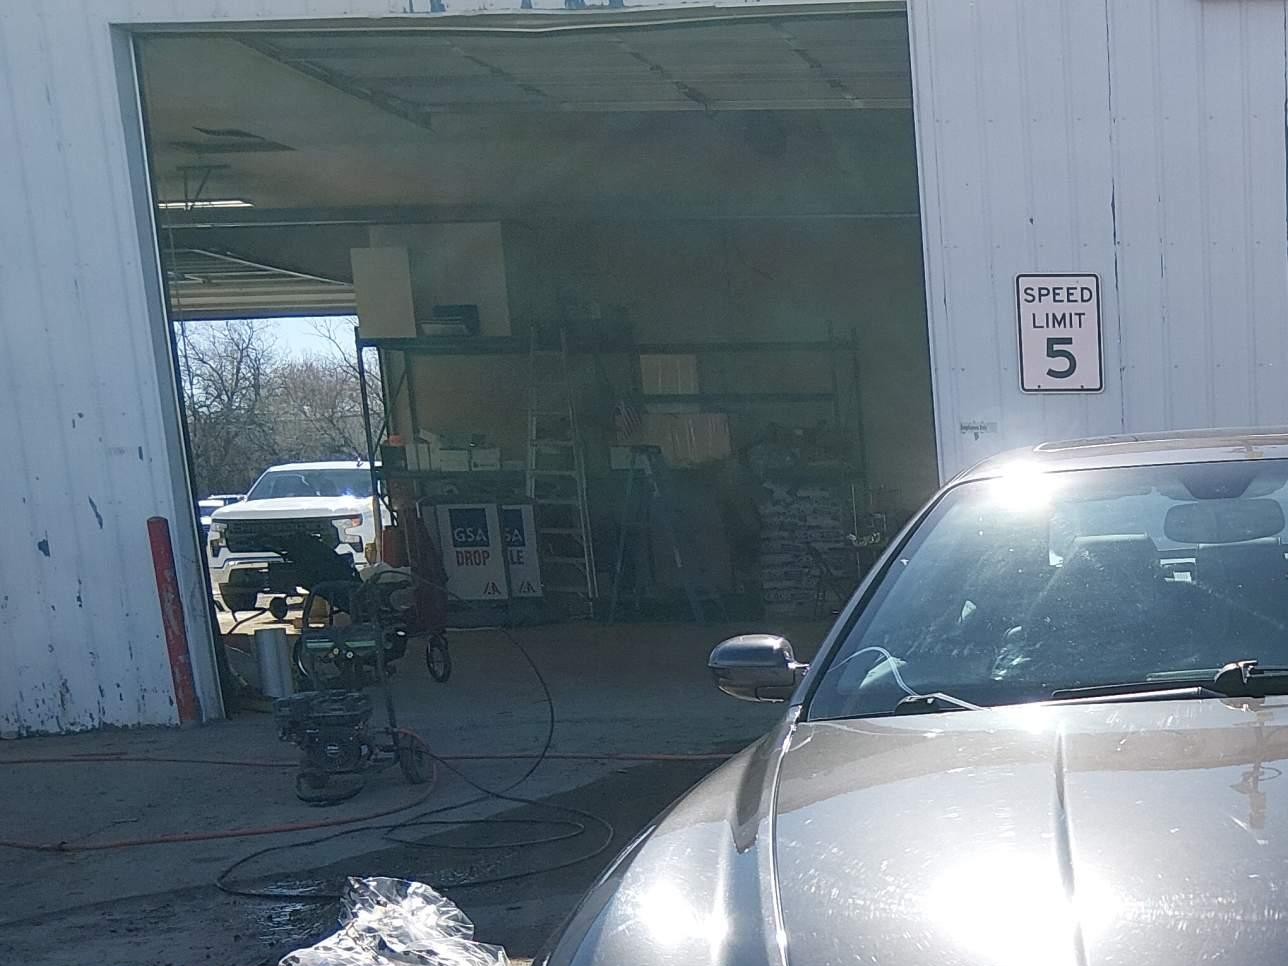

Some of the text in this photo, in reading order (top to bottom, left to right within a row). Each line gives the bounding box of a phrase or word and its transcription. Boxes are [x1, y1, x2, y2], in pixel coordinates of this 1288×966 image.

[1023, 287, 1093, 303] SPEED
[1032, 313, 1086, 329] LIMIT
[1046, 337, 1077, 379] 5
[454, 527, 487, 542] GSA
[456, 550, 490, 567] DROP
